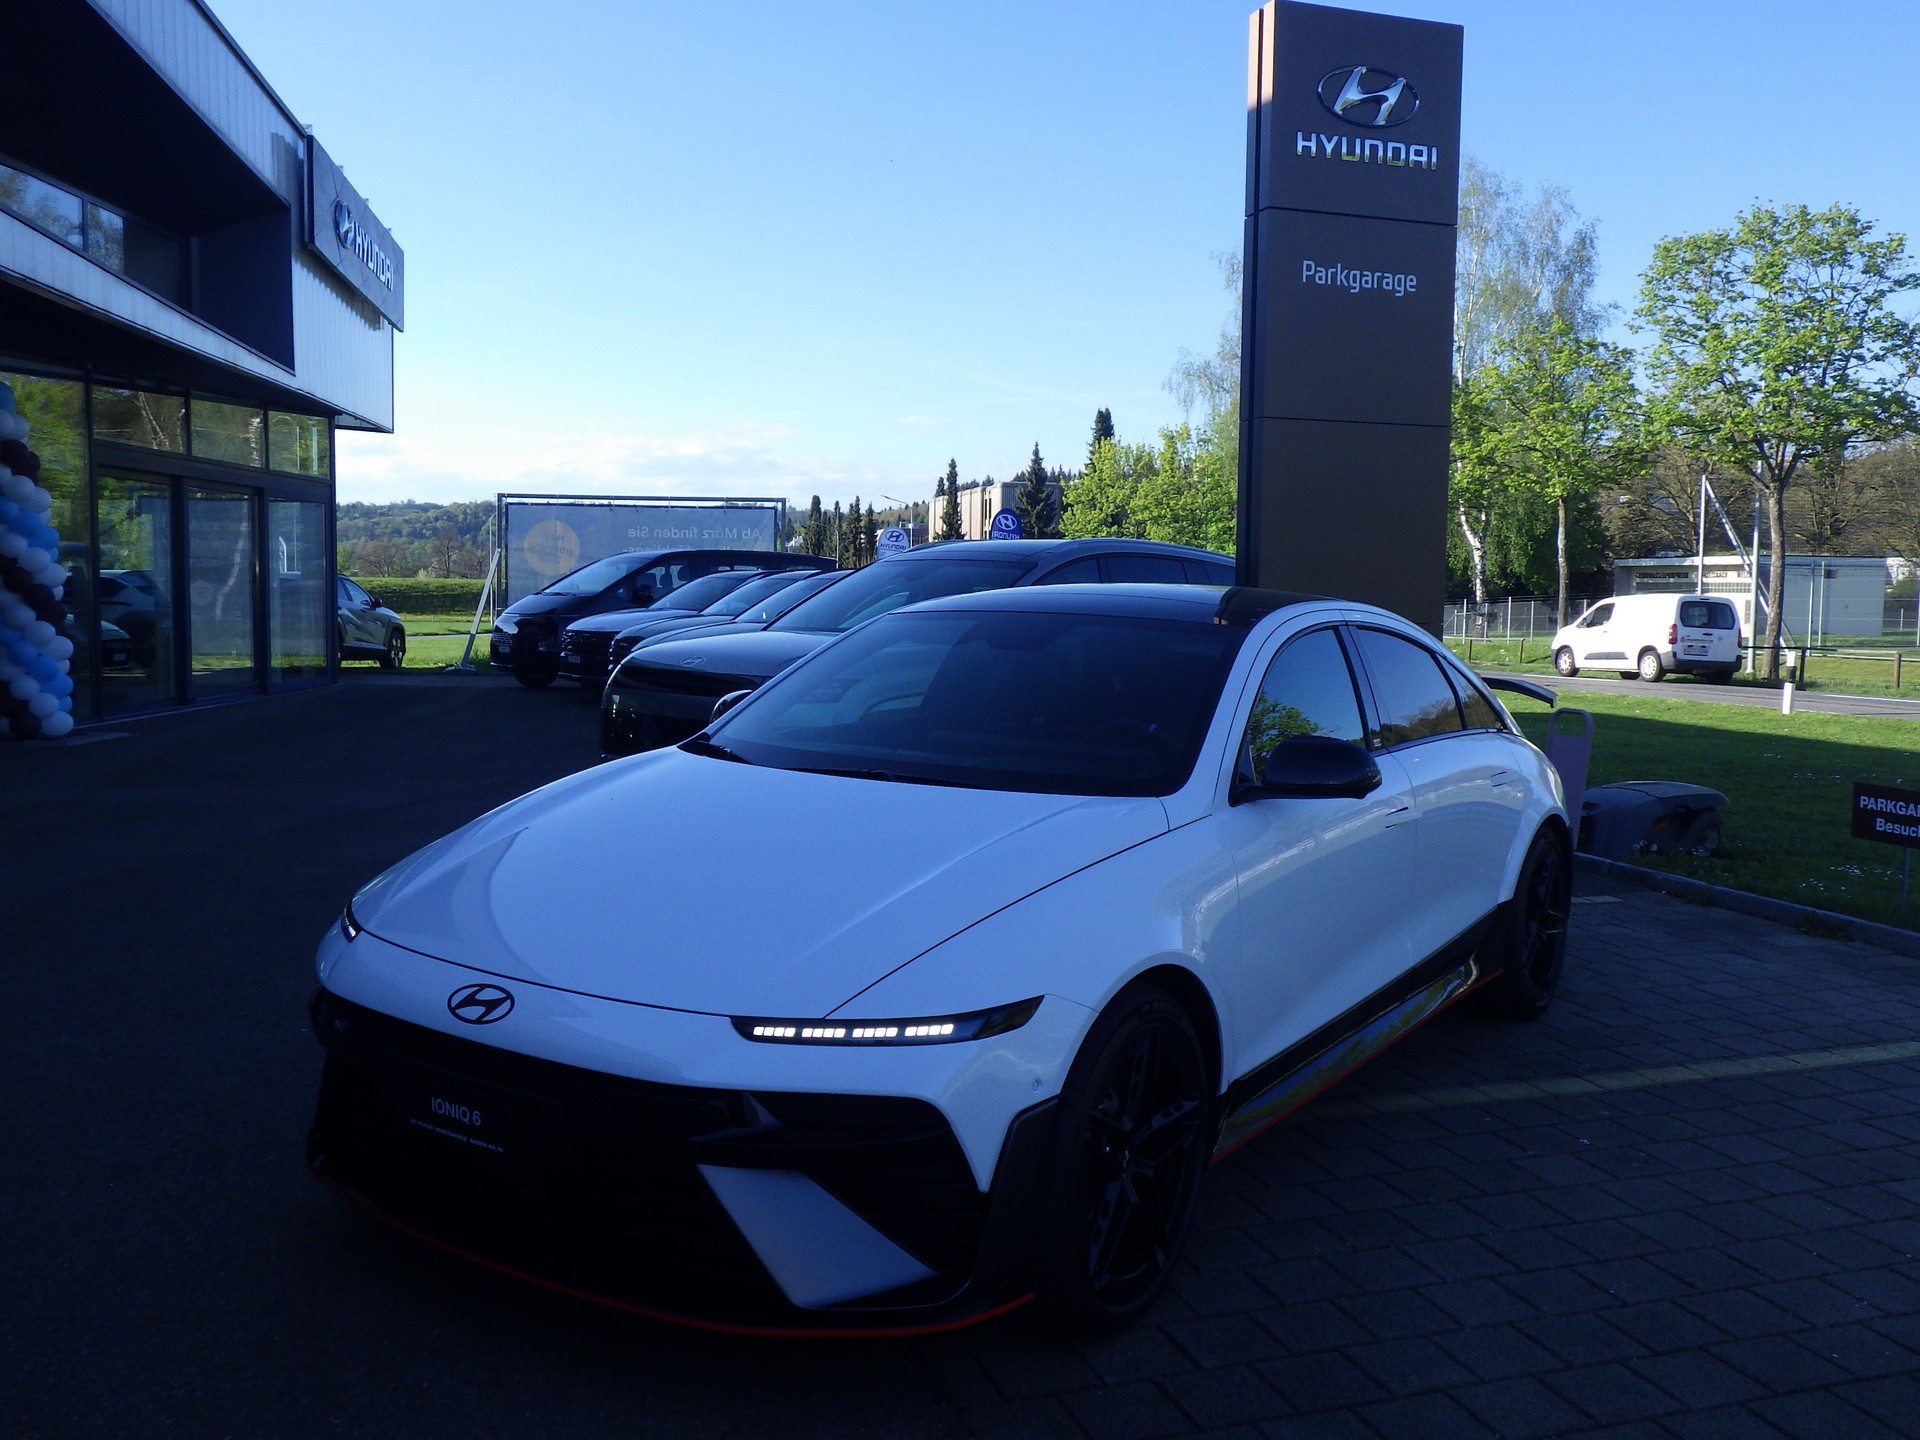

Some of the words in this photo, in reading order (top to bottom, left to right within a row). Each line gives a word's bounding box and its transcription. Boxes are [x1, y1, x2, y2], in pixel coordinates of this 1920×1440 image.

[1296, 131, 1438, 171] HYUNDAI
[354, 220, 394, 292] HYUNDAI
[1302, 259, 1417, 297] Parkgarage
[880, 543, 907, 551] HYUNDAI
[1859, 795, 1920, 817] PARKGA
[1875, 817, 1920, 837] Besuc
[431, 1096, 470, 1126] IONIQ
[472, 1110, 481, 1126] 6
